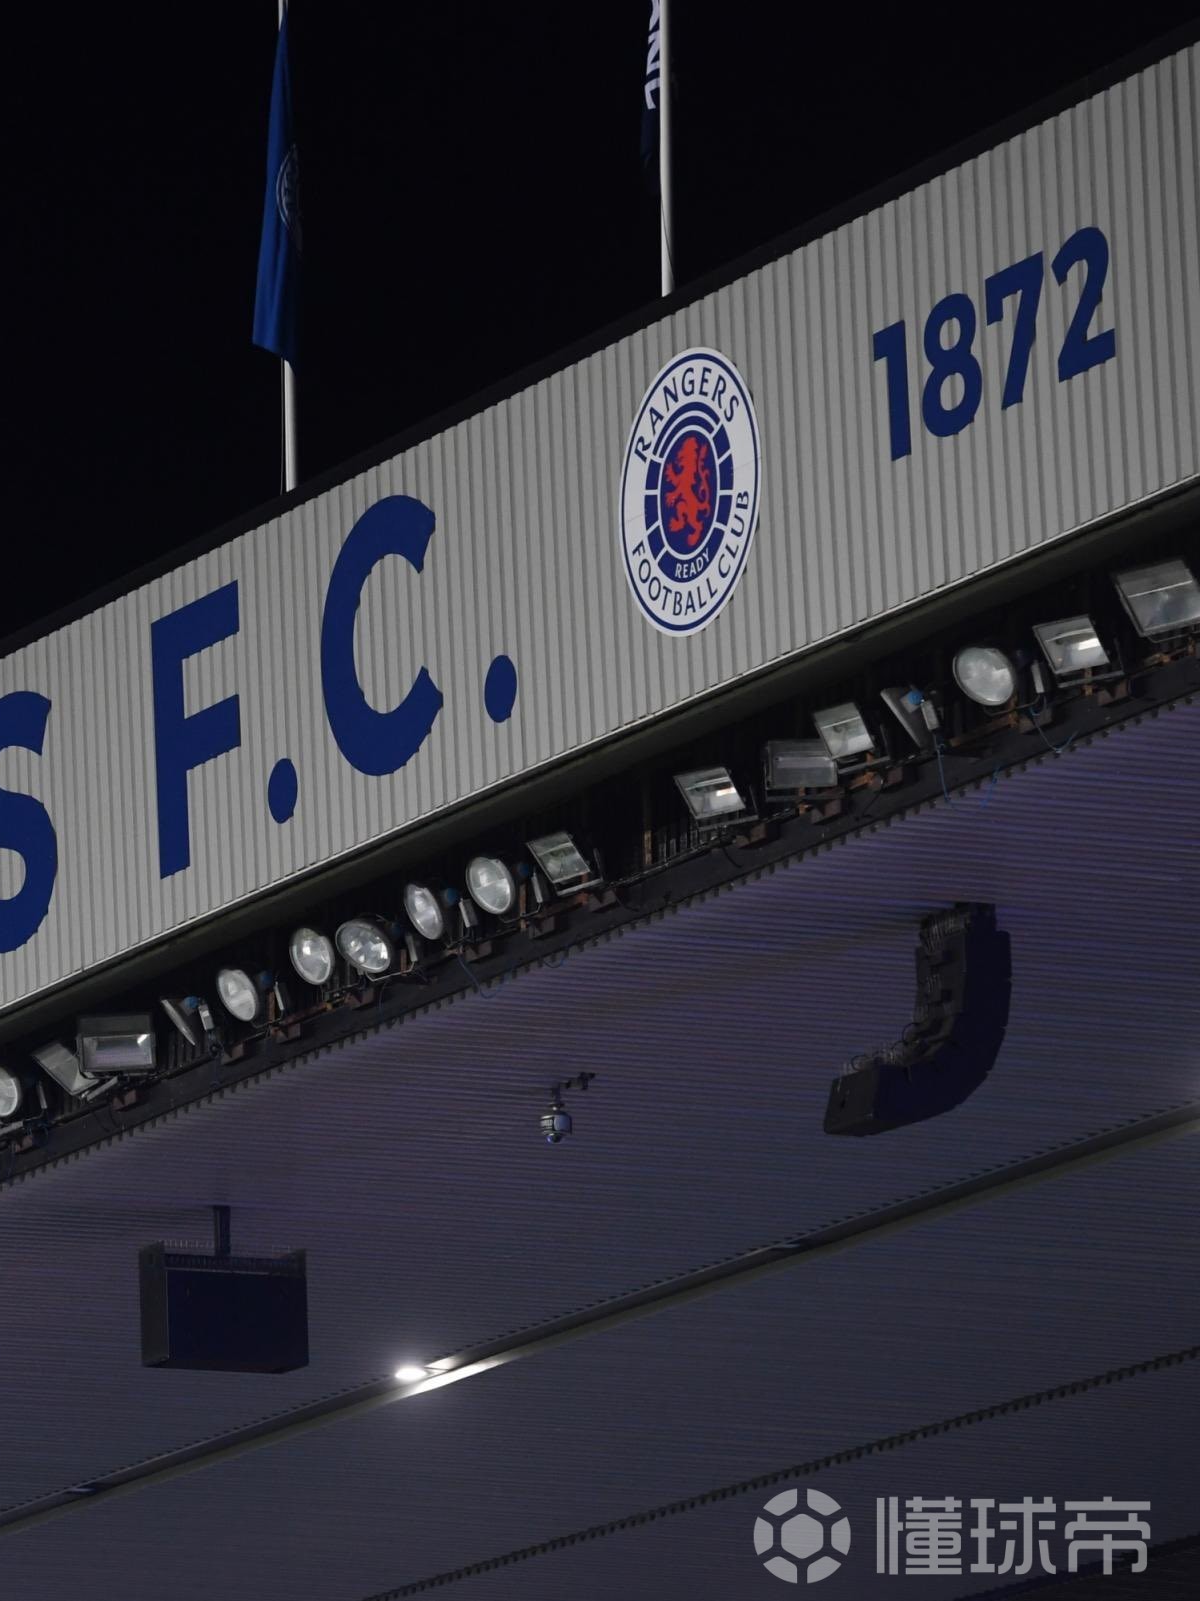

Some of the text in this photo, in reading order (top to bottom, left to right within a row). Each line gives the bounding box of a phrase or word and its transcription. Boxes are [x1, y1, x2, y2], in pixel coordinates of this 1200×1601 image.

[873, 227, 1115, 461] 1872
[634, 367, 739, 463] RANGERS
[632, 490, 750, 617] FOOTBALL CLUB
[675, 547, 710, 580] READY
[152, 496, 517, 877] F.C.
